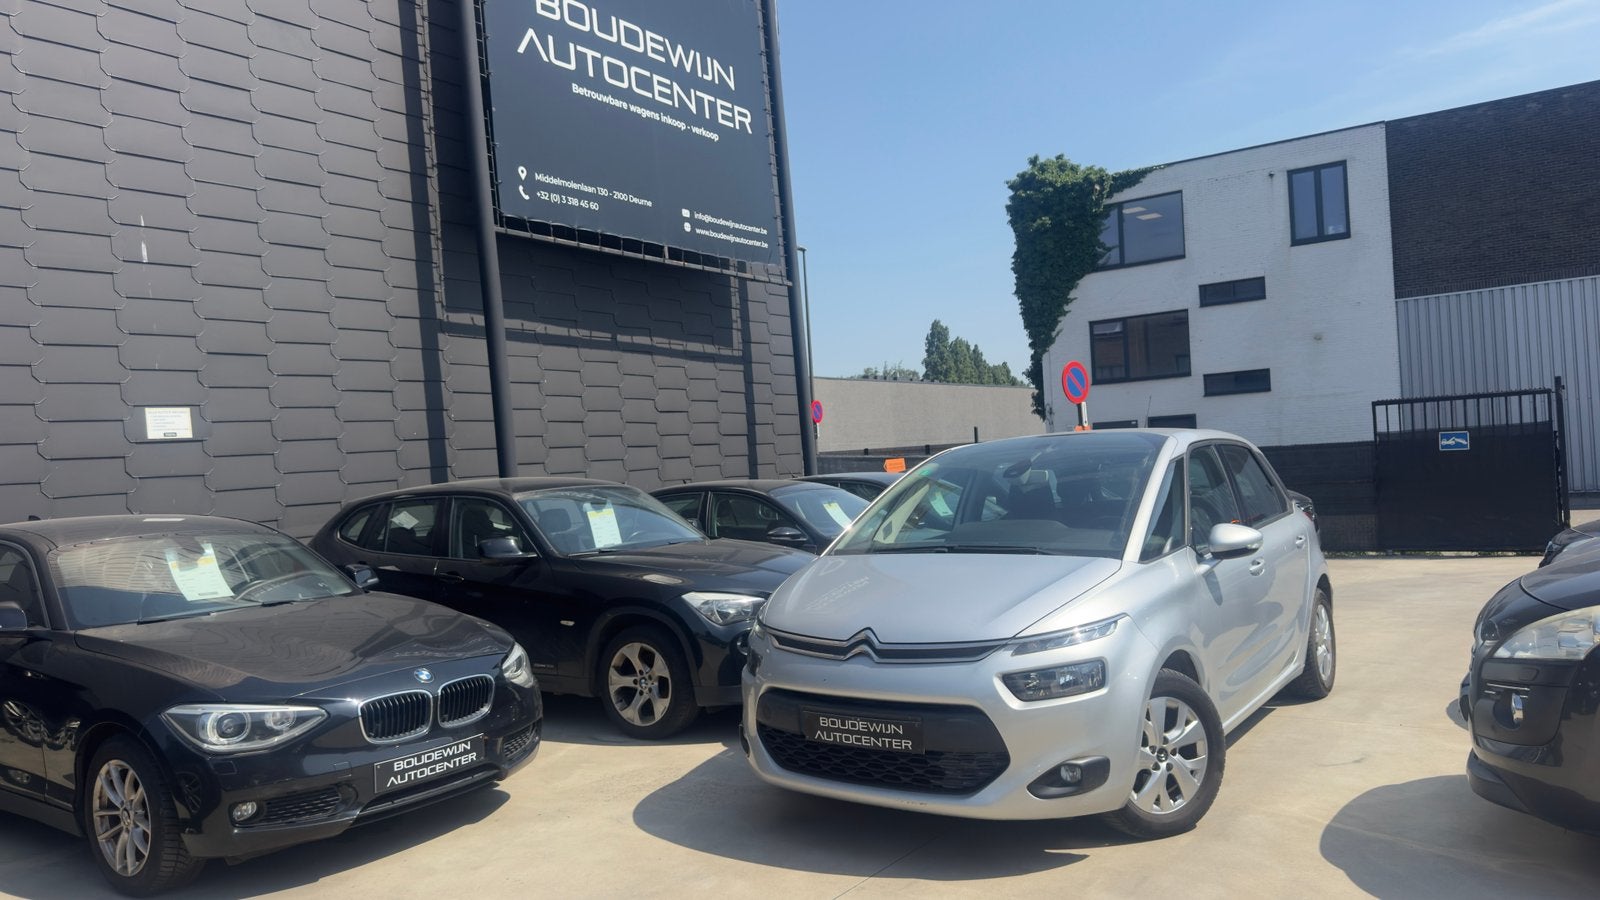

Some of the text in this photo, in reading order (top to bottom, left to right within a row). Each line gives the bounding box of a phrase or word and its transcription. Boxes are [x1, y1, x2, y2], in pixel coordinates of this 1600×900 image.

[536, 0, 736, 91] BOUDEWIJN
[517, 27, 753, 134] AUTOCENTER
[572, 82, 628, 111] Betrouwbare
[628, 101, 660, 123] wagens
[660, 112, 687, 132] inkoop
[691, 123, 720, 143] verkoop
[534, 172, 597, 194] Middelmolenlaan
[597, 186, 609, 197] 130
[613, 190, 629, 202] 2100
[629, 193, 653, 208] Deurne
[536, 190, 600, 211] +32 (0) 3 318 45 60
[694, 211, 768, 236] info@boudewijnautocenter.be
[695, 227, 769, 249] www.boudewijnautocenter.be
[814, 730, 913, 750] AUTOCENTER
[820, 716, 904, 735] BOUDEWIJN
[386, 752, 477, 788] AUTOCENTER
[393, 741, 471, 772] BOUDEWIJN
